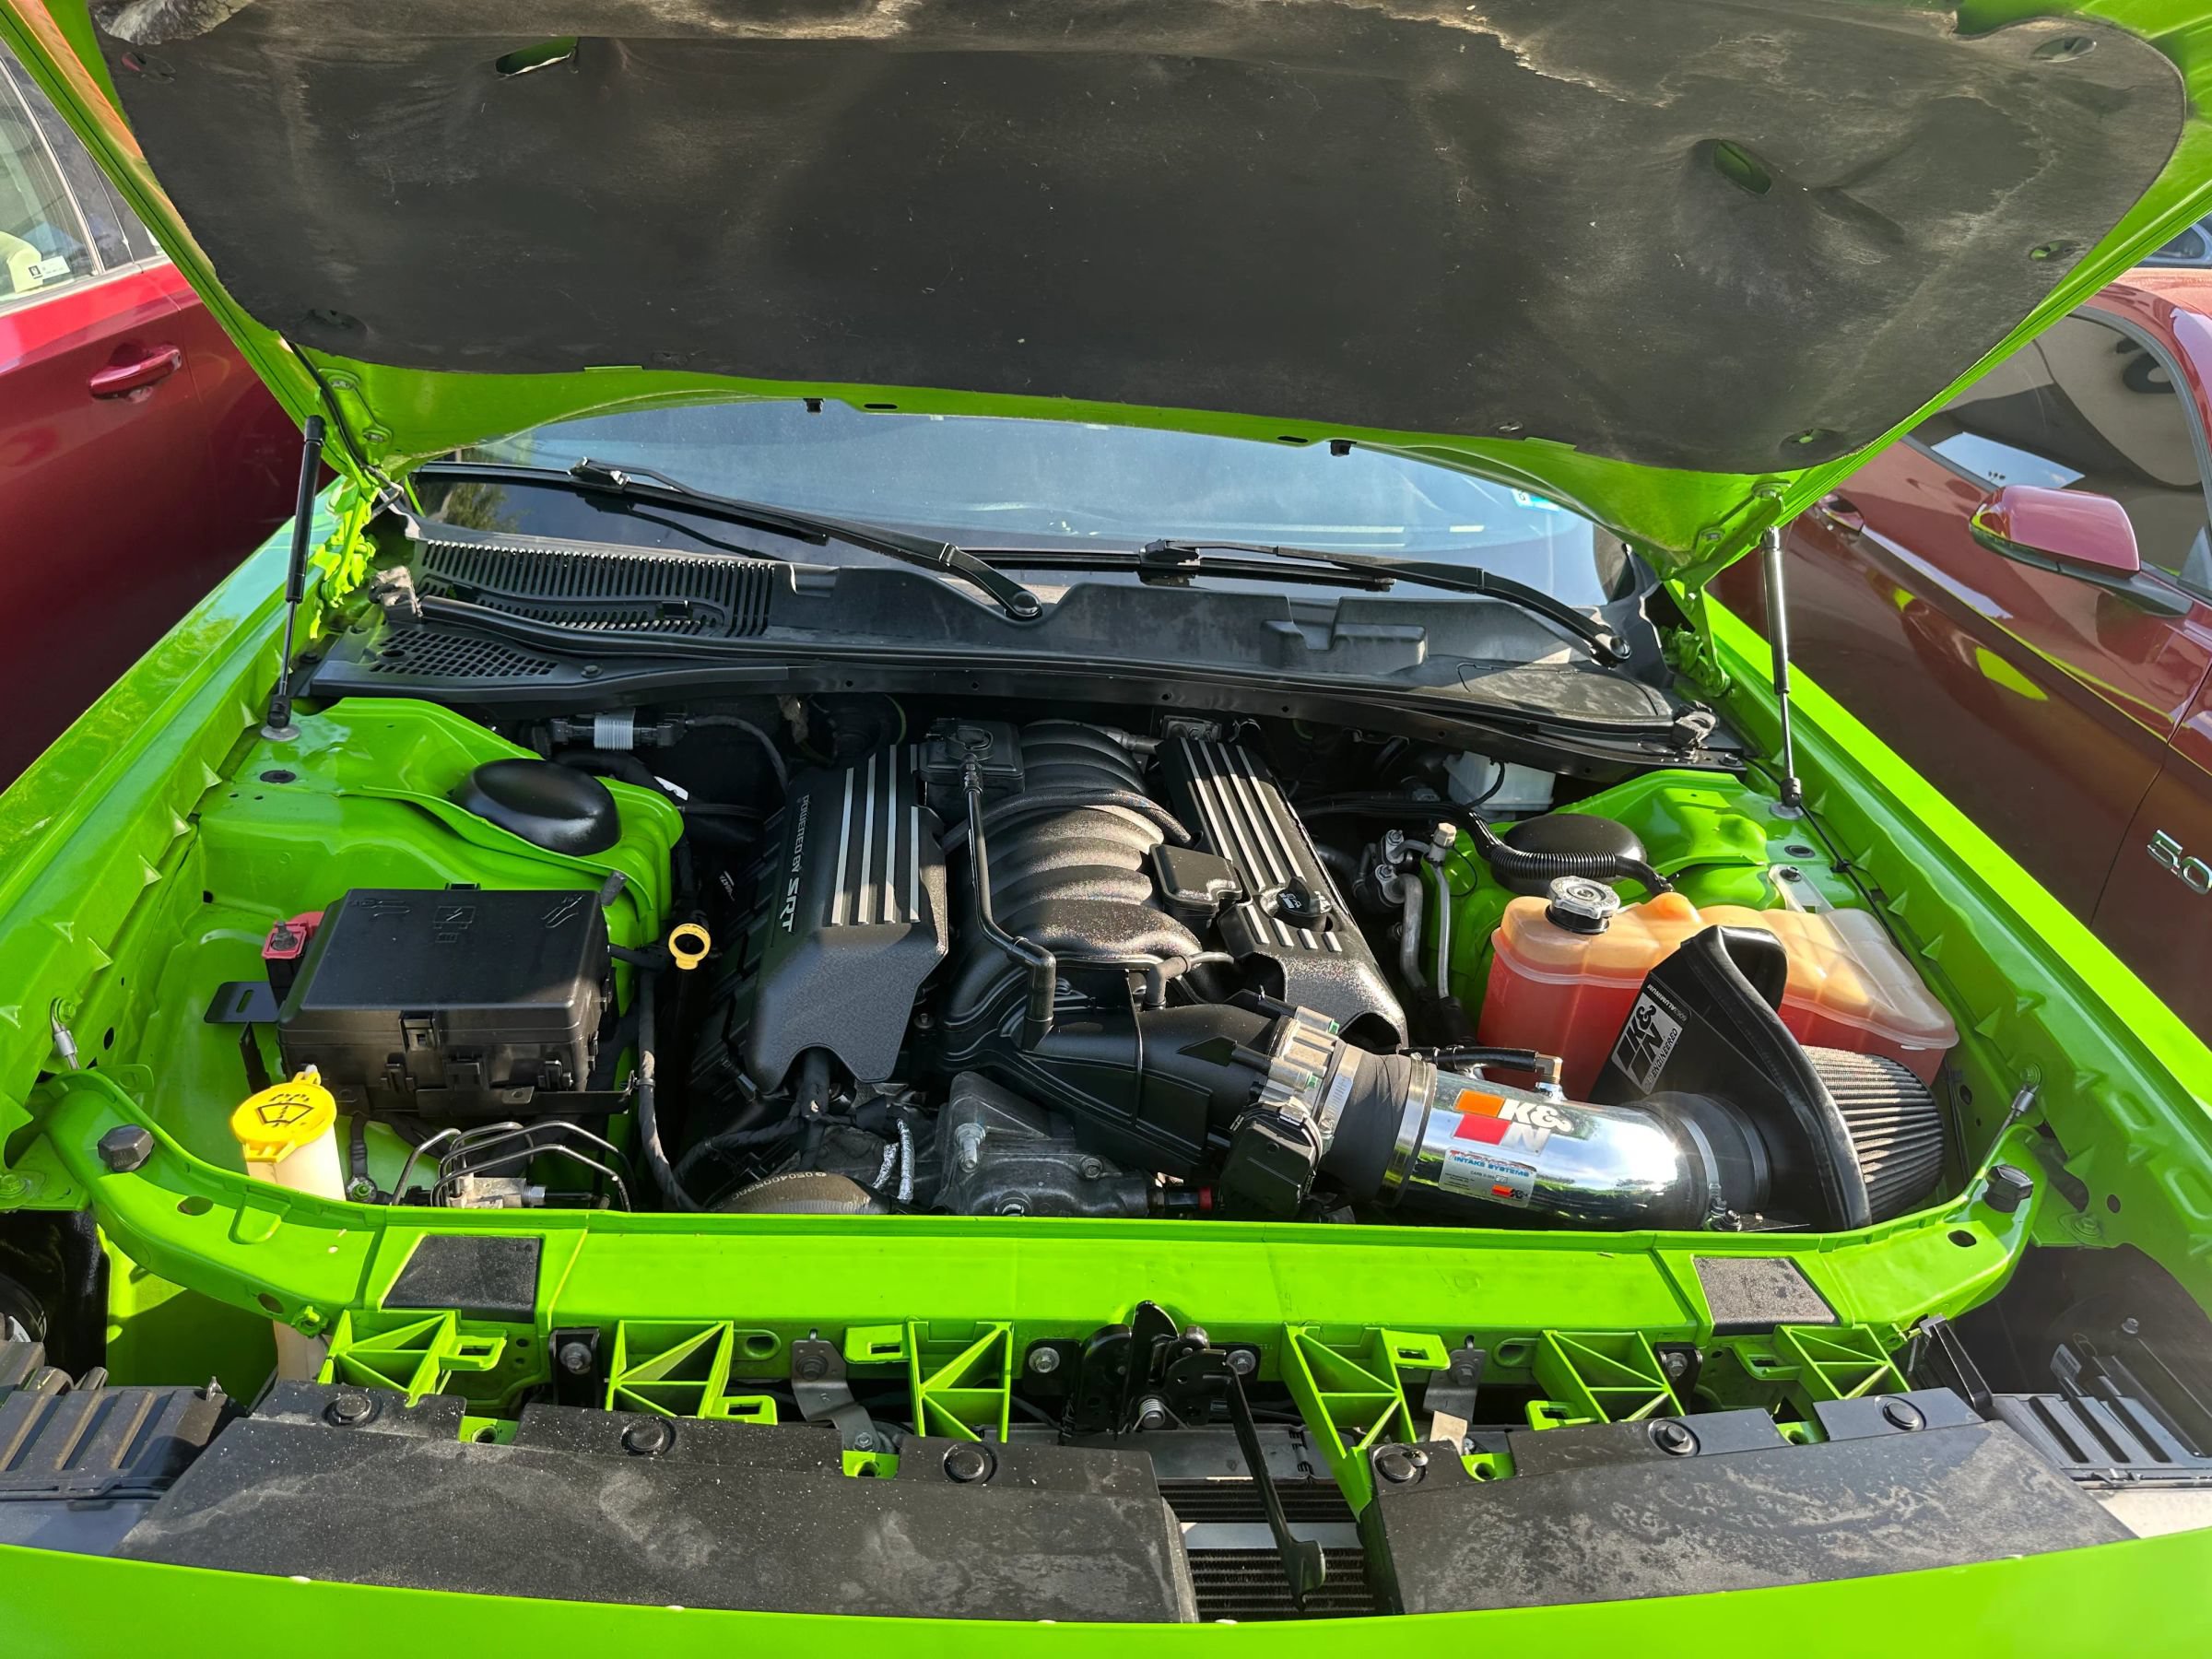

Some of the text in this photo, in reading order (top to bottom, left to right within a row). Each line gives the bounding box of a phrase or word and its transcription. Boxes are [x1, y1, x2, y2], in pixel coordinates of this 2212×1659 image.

[780, 794, 809, 933] POWERED BY SRT
[2147, 830, 2212, 895] 5.0
[1498, 1099, 1574, 1152] K&N
[1453, 1157, 1530, 1177] INTAKE SYSTEMS
